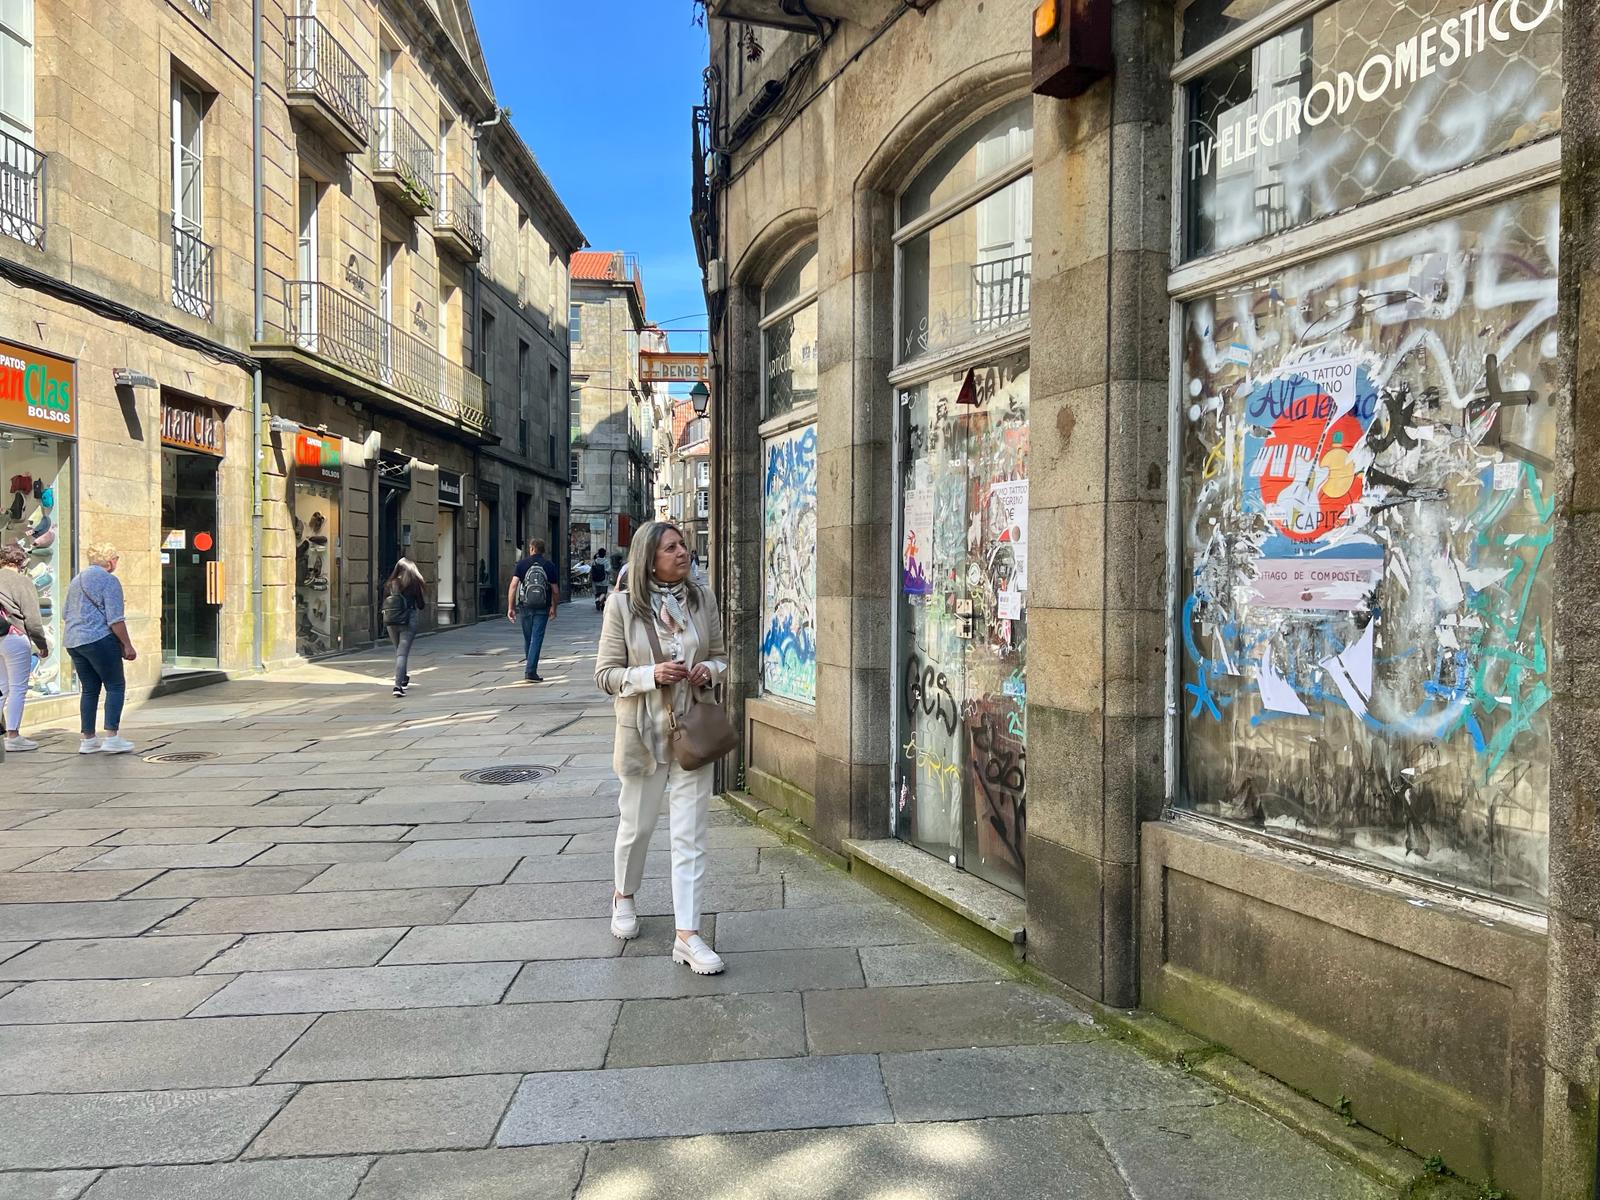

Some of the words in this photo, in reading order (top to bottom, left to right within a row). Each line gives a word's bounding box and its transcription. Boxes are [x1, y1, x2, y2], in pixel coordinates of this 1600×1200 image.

[1312, 364, 1352, 380] TATTOO
[28, 405, 71, 424] BOLSOS
[1295, 510, 1353, 531] CAPIT
[1294, 571, 1304, 580] DE
[1310, 570, 1370, 583] COMPOSTE
